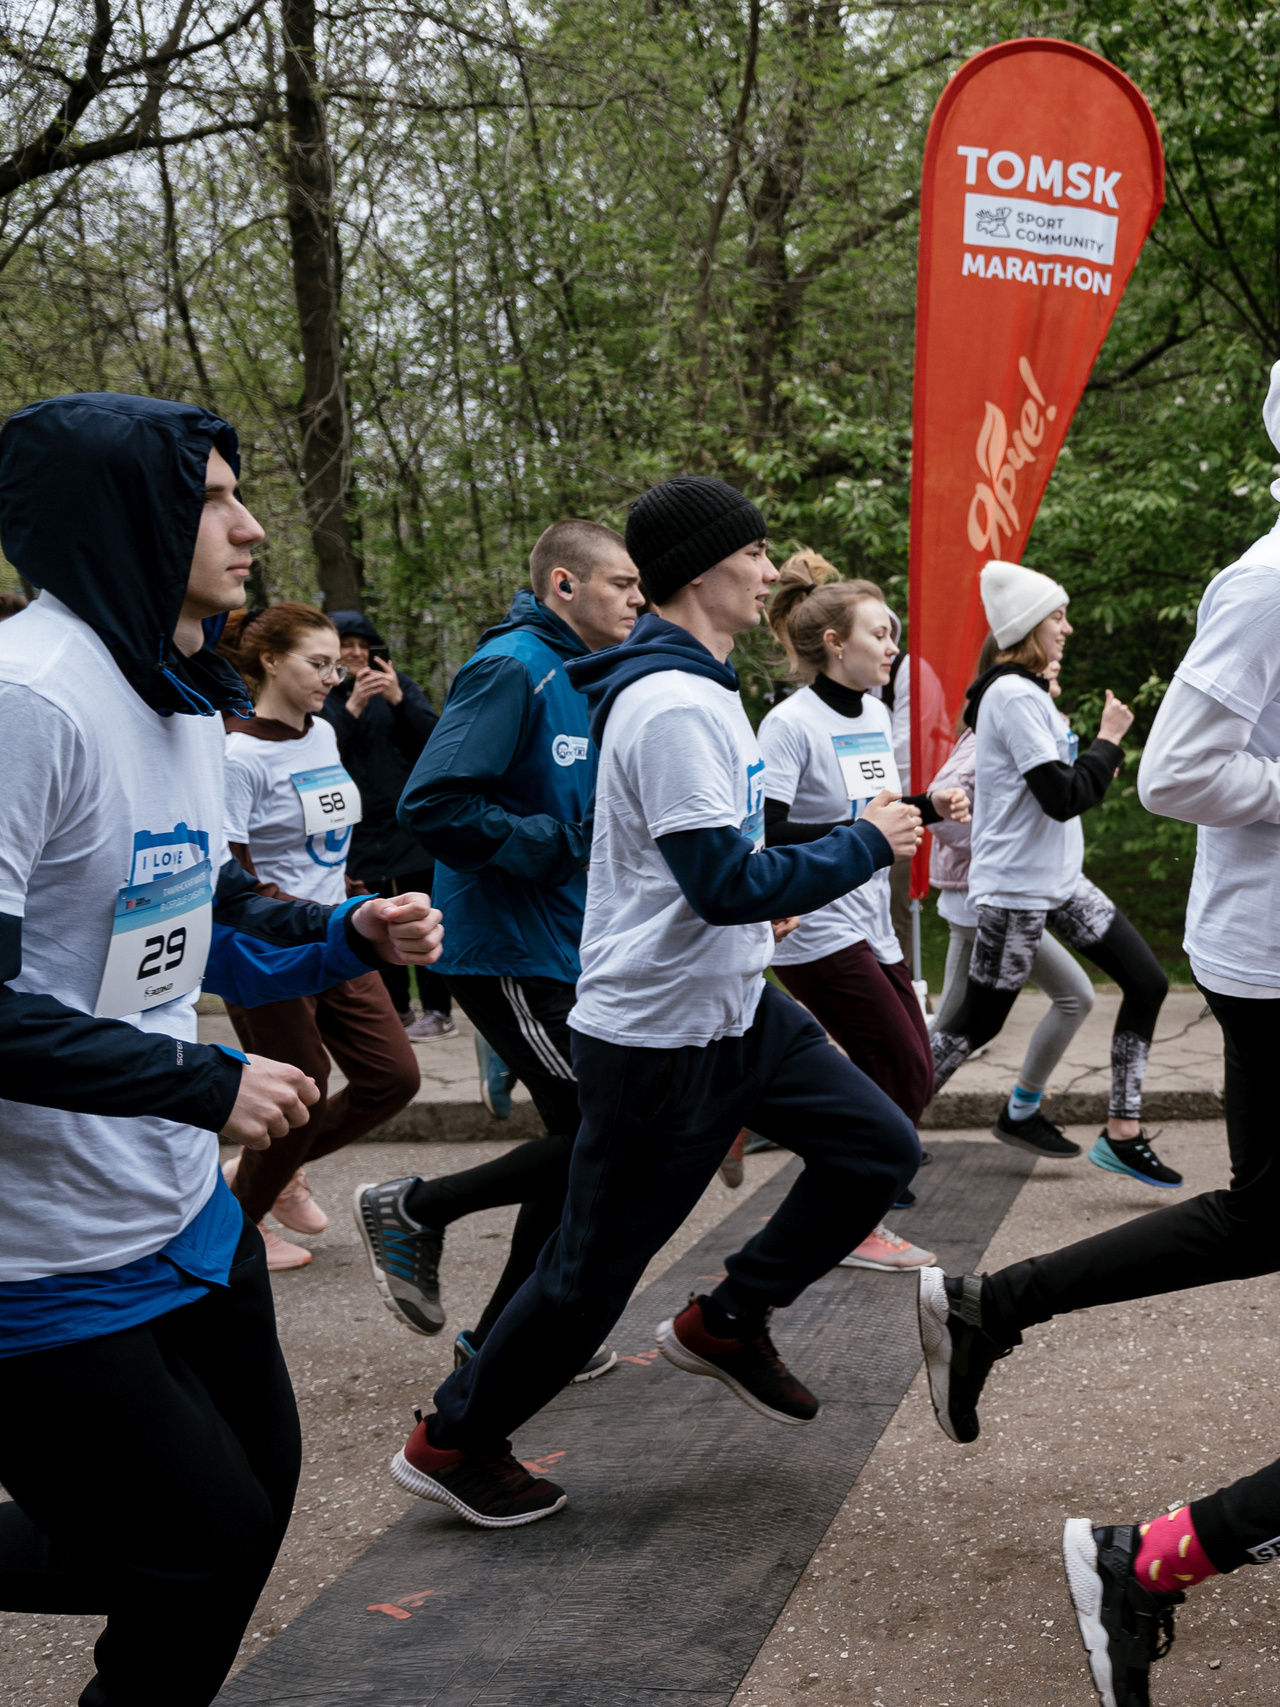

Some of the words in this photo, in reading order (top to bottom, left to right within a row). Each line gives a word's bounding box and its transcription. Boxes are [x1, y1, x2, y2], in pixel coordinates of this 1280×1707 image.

[957, 145, 1122, 209] TOMSK
[1016, 211, 1065, 230] SPORT
[1015, 229, 1105, 254] COMMUNITY
[961, 252, 1112, 296] MARATHON
[859, 759, 885, 780] 55
[318, 791, 346, 814] 58
[142, 856, 147, 870] I
[153, 850, 183, 868] LOVE
[136, 926, 187, 981] 29
